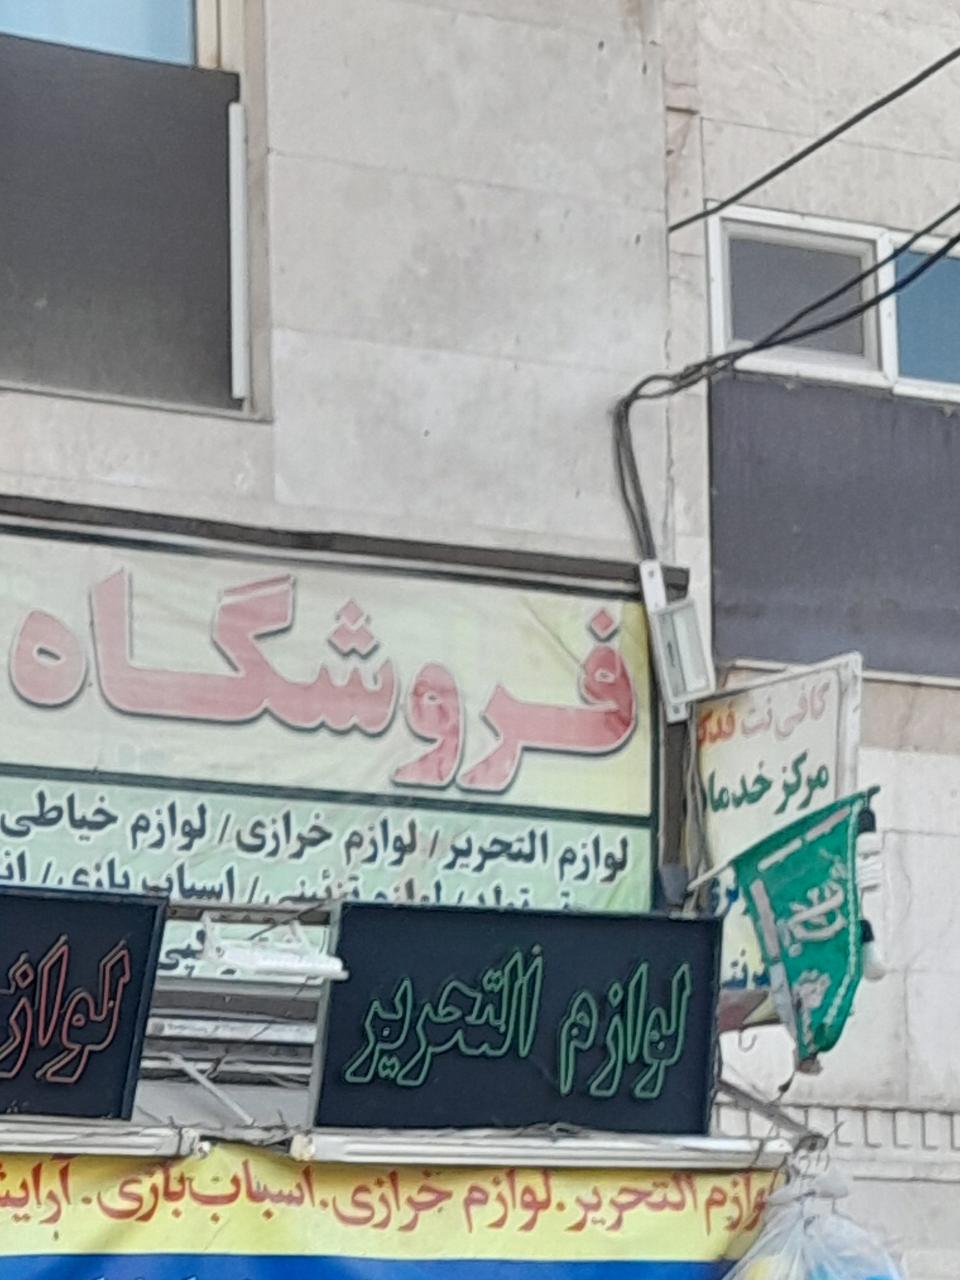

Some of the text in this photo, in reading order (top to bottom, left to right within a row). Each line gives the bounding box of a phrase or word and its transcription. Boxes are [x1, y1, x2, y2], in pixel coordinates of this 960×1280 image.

[11, 567, 637, 793] فروشگاه
[707, 750, 830, 815] مرکز خدما
[0, 789, 119, 842] خیاطی
[130, 800, 207, 850] لوازم
[235, 808, 333, 859] خرازی
[343, 816, 418, 866] لوازم
[442, 829, 548, 873] التحریر
[558, 834, 628, 883] لوازم
[345, 944, 694, 1100] لوازم التحریر
[463, 1167, 553, 1234] لوازم
